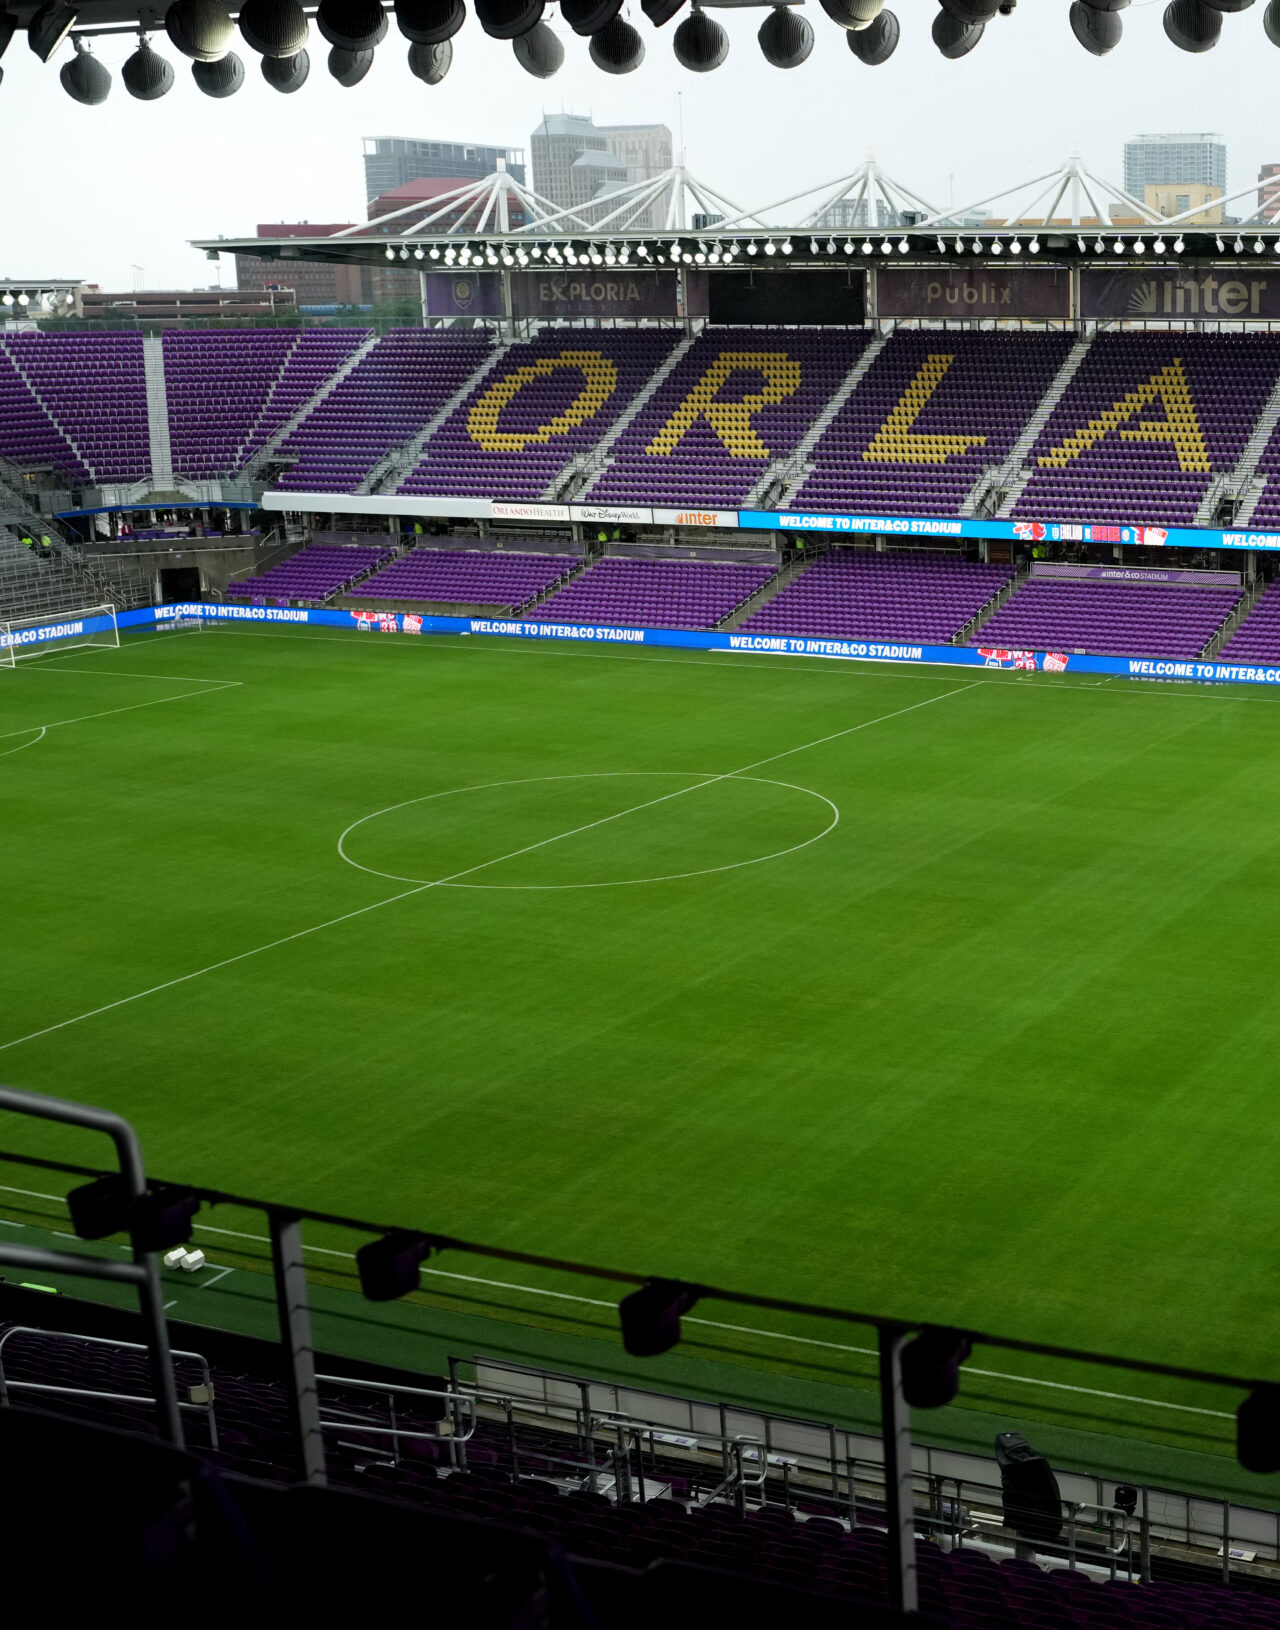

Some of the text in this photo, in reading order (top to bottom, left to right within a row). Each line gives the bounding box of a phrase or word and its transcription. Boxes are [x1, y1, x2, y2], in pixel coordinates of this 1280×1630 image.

[539, 279, 640, 302] EXPLORIA
[927, 282, 1012, 304] Publix
[1164, 274, 1267, 314] inter
[492, 506, 533, 516] ORLANDO
[685, 512, 718, 526] inter
[779, 515, 962, 534] WELCOME TO INTER&CO STADIUM
[1140, 572, 1169, 580] STADIUM
[154, 605, 308, 622] WELCOME TO INTER&CO STADIUM
[38, 621, 84, 640] STADIUM
[470, 620, 645, 642] WELCOME TO INTER&CO STADIUM
[730, 636, 923, 660] WELCOME TO INTER&CO STADIUM
[1128, 660, 1195, 676] WELCOME
[1195, 664, 1214, 678] TO
